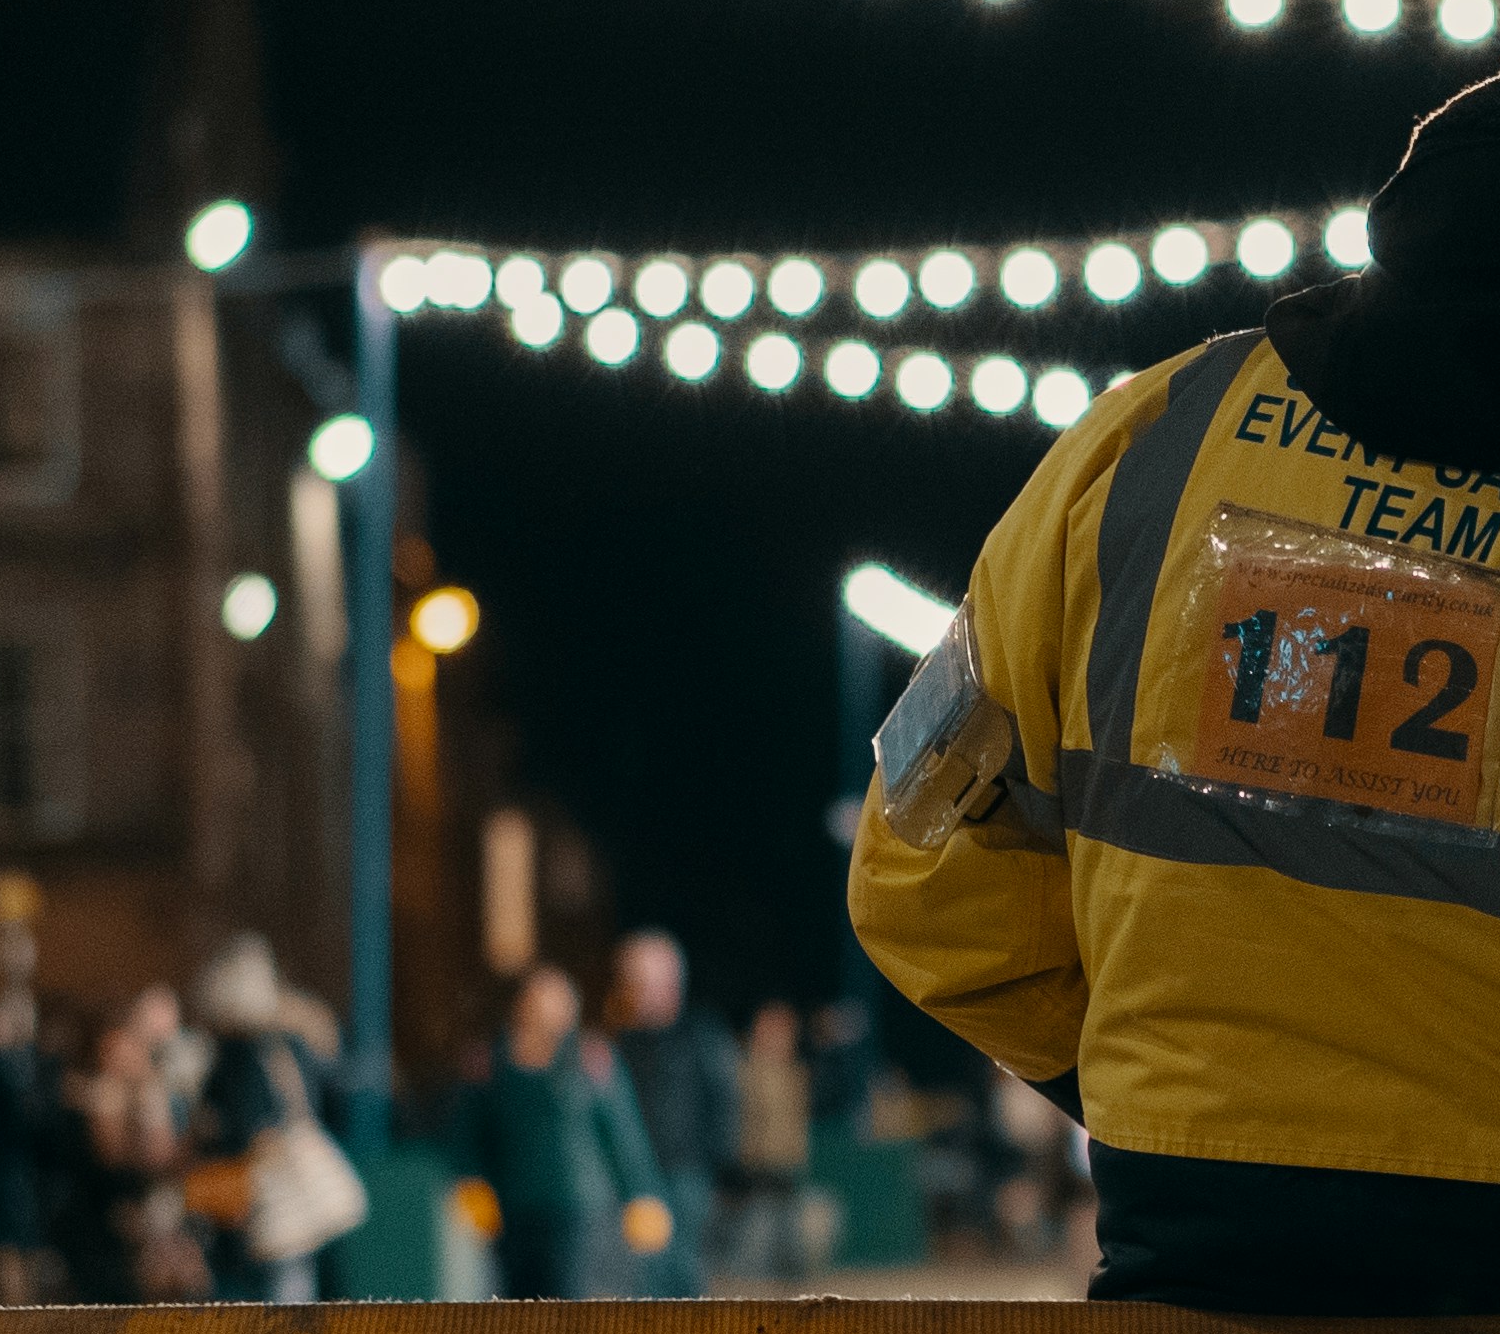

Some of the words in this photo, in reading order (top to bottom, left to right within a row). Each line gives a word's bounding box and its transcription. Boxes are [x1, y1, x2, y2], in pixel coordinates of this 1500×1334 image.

[1223, 609, 1478, 763] 112
[1216, 745, 1284, 774] HERE
[1289, 758, 1320, 779] TO
[1325, 766, 1406, 796] ASSIST
[1412, 780, 1461, 806] YOU
